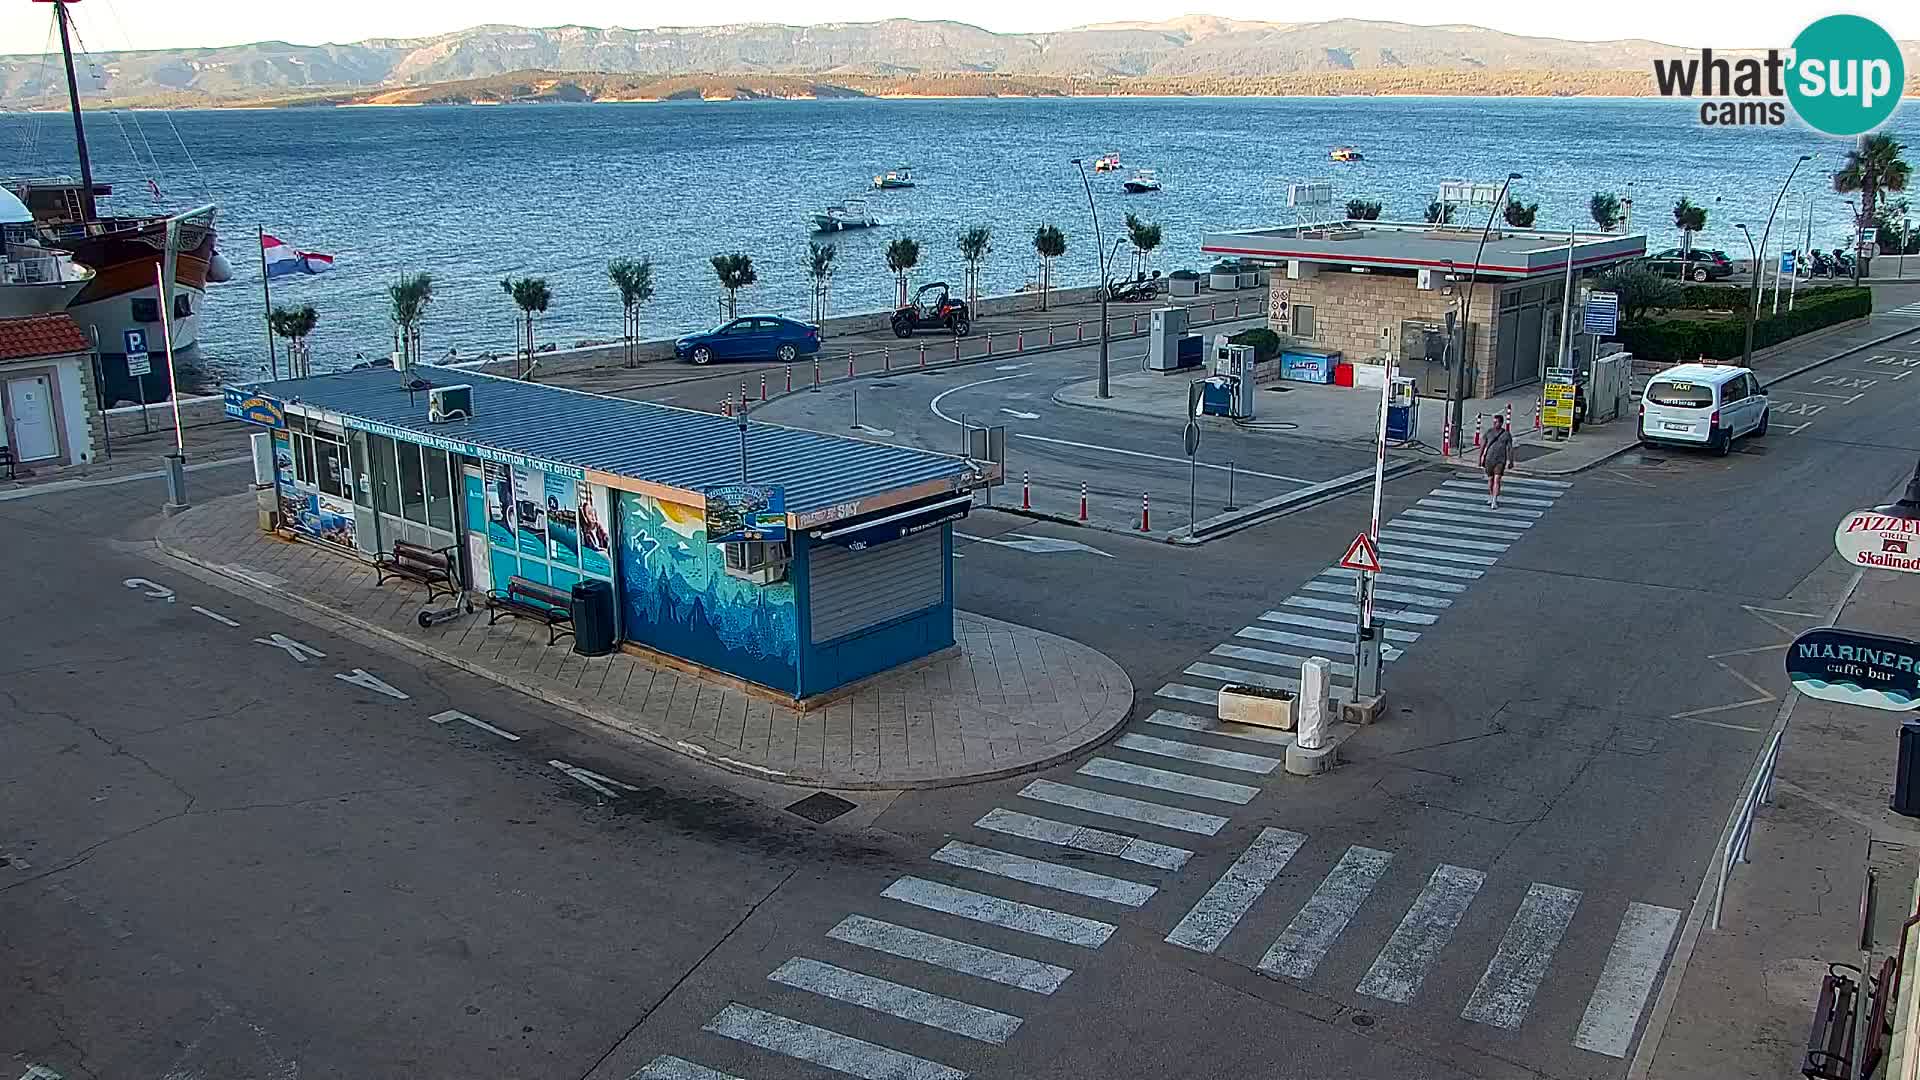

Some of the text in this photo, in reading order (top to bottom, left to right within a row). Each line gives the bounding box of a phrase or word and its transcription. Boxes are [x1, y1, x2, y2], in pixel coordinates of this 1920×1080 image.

[1672, 383, 1692, 391] TAXI
[395, 428, 435, 445] AUTOBUSNA
[435, 437, 466, 453] POSTAJA
[477, 448, 582, 478] BUS STATION TICKET OFFICE
[1879, 531, 1912, 541] GRILL
[1826, 663, 1896, 681] caffe bar
